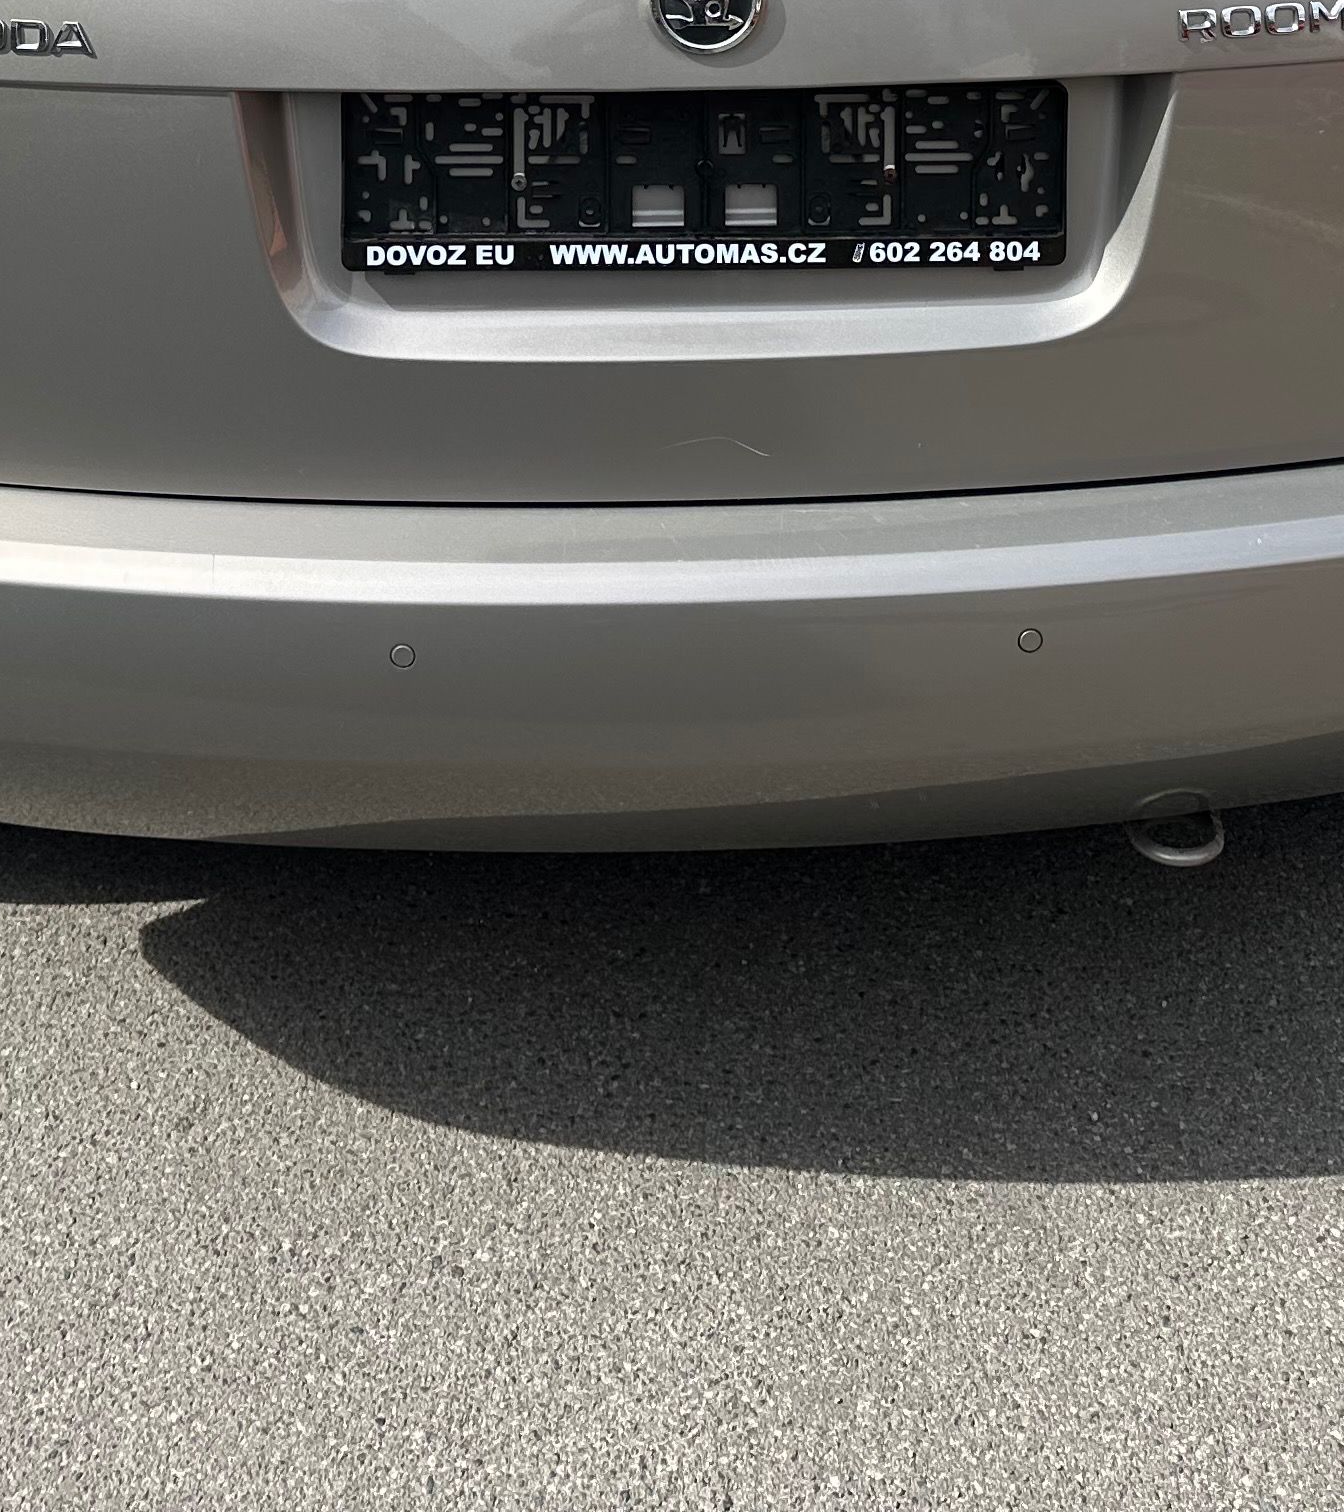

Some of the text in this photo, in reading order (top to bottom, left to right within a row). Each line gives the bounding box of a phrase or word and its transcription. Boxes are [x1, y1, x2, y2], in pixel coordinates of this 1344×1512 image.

[366, 240, 1041, 266] DOVOZ EU WWW.AUTOMAS.CZ 602 264 804
